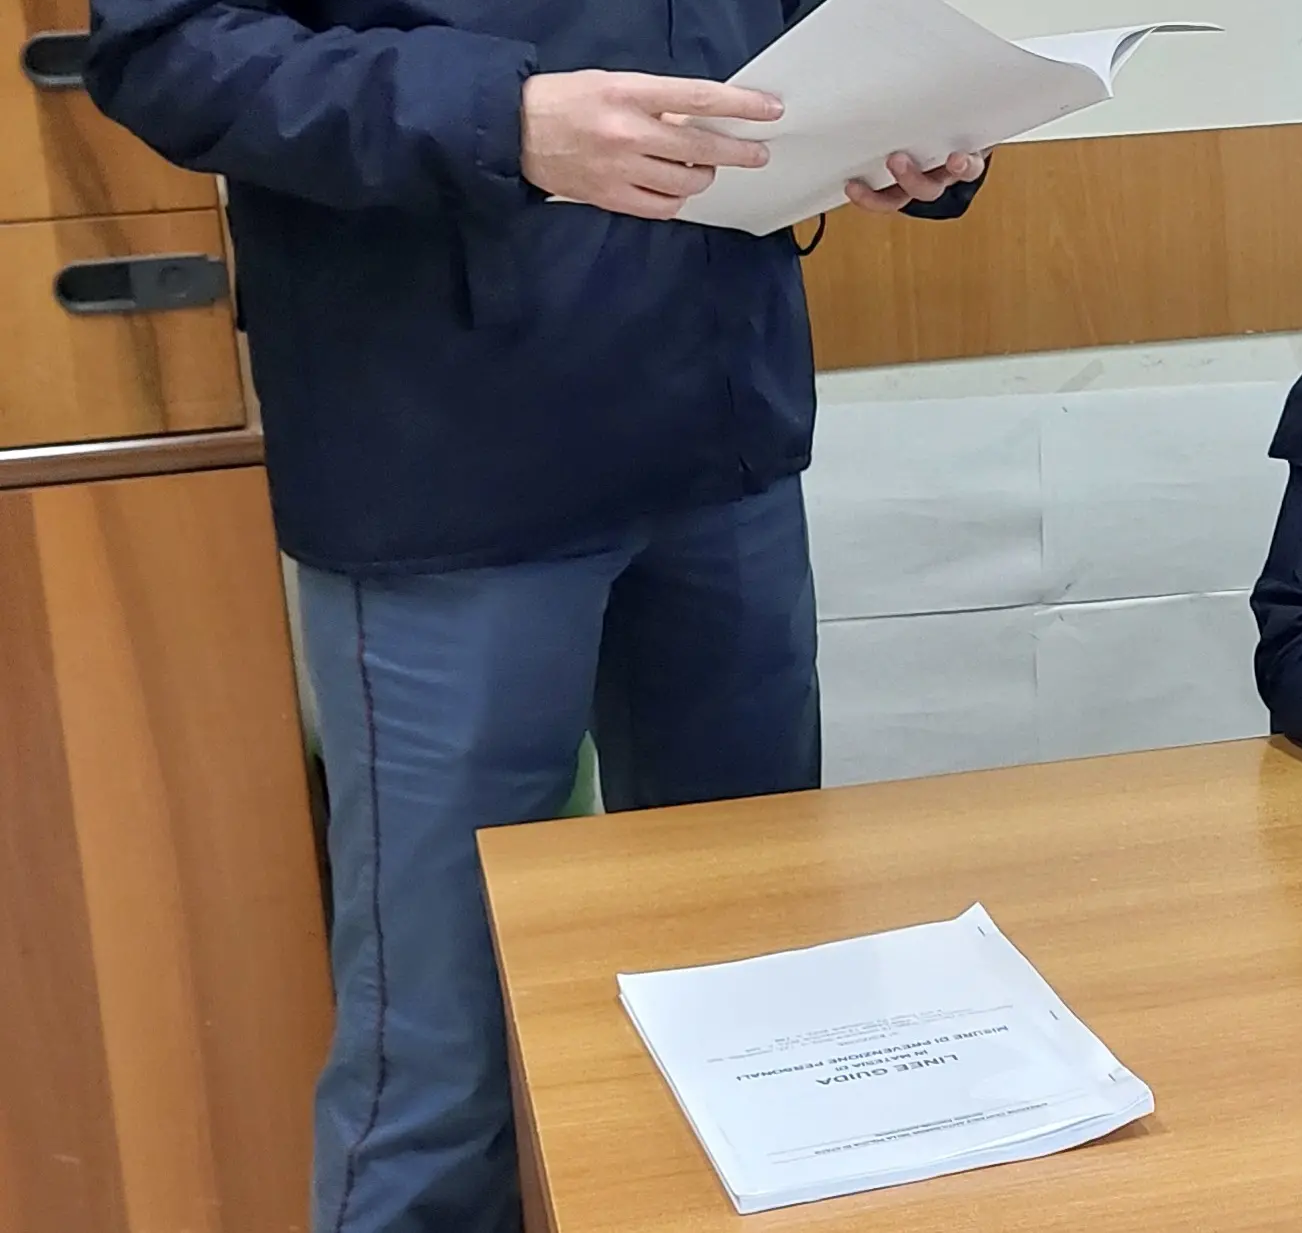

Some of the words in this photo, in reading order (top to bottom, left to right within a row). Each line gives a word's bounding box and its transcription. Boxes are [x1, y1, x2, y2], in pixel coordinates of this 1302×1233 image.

[827, 1040, 932, 1065] PREVENZIONE
[893, 1053, 959, 1073] LINEE
[815, 1067, 889, 1086] GUIDA
